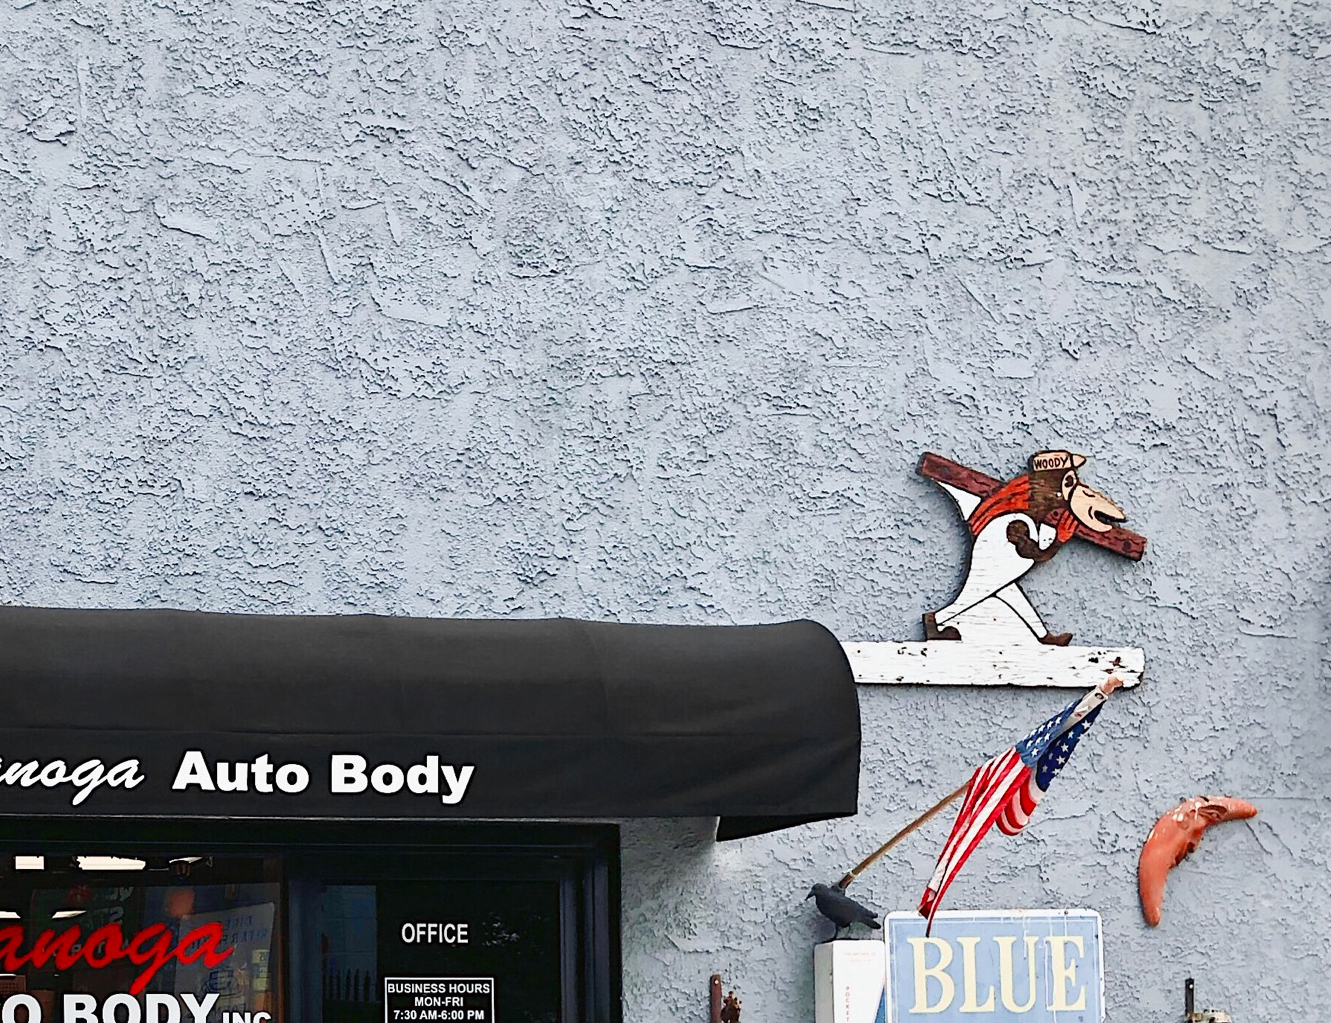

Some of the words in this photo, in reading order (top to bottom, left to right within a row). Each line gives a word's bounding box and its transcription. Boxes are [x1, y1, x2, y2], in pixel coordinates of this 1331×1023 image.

[1034, 457, 1069, 469] WOODY
[172, 750, 310, 793] Auto
[330, 754, 475, 804] Body
[401, 923, 469, 943] OFFICE
[907, 935, 1086, 1014] BLUE
[387, 983, 446, 994] BUSINESS
[448, 983, 491, 993] HOURS
[414, 997, 464, 1007] MON-FRI
[393, 1010, 417, 1020] 7:30
[419, 1010, 464, 1020] AM-6:00
[467, 1010, 485, 1020] PM
